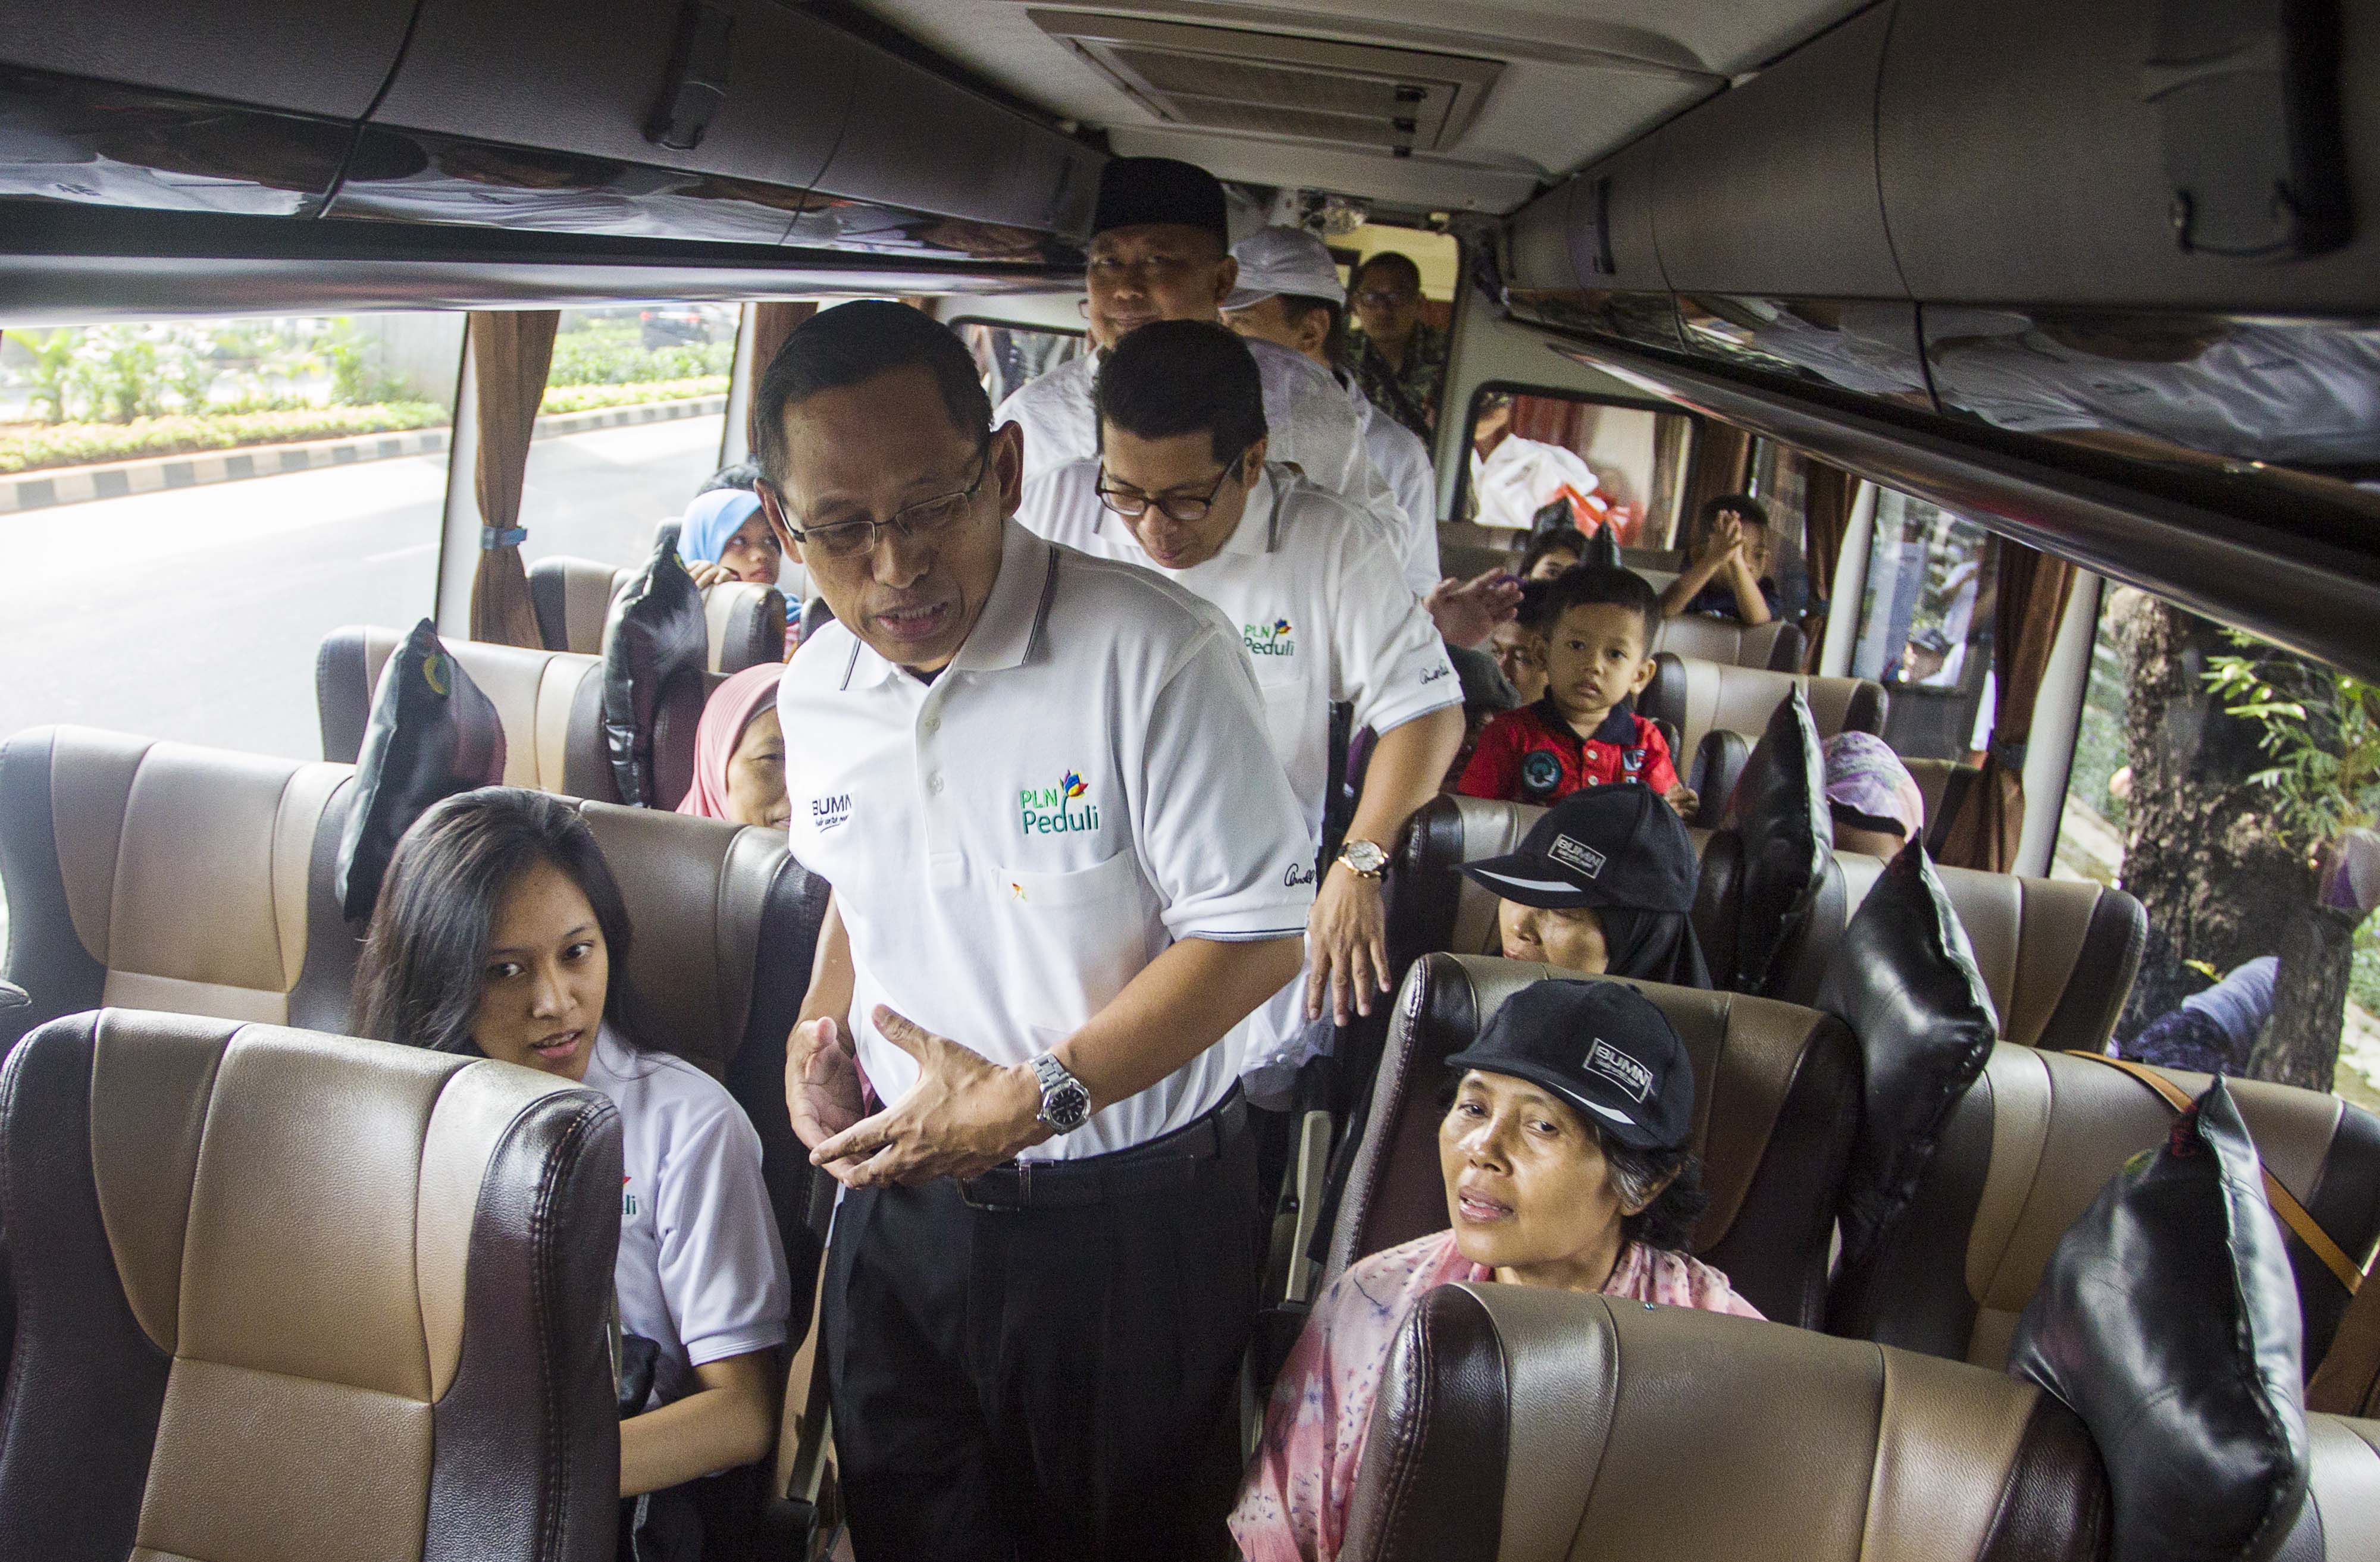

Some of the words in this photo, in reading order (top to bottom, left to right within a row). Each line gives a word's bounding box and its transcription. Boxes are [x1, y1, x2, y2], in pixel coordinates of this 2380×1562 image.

[1244, 624, 1270, 638] PLN
[812, 792, 853, 815] BUMN
[1020, 788, 1057, 809] PLN
[1022, 804, 1099, 835] Peduli
[1595, 1045, 1651, 1087] BUMN
